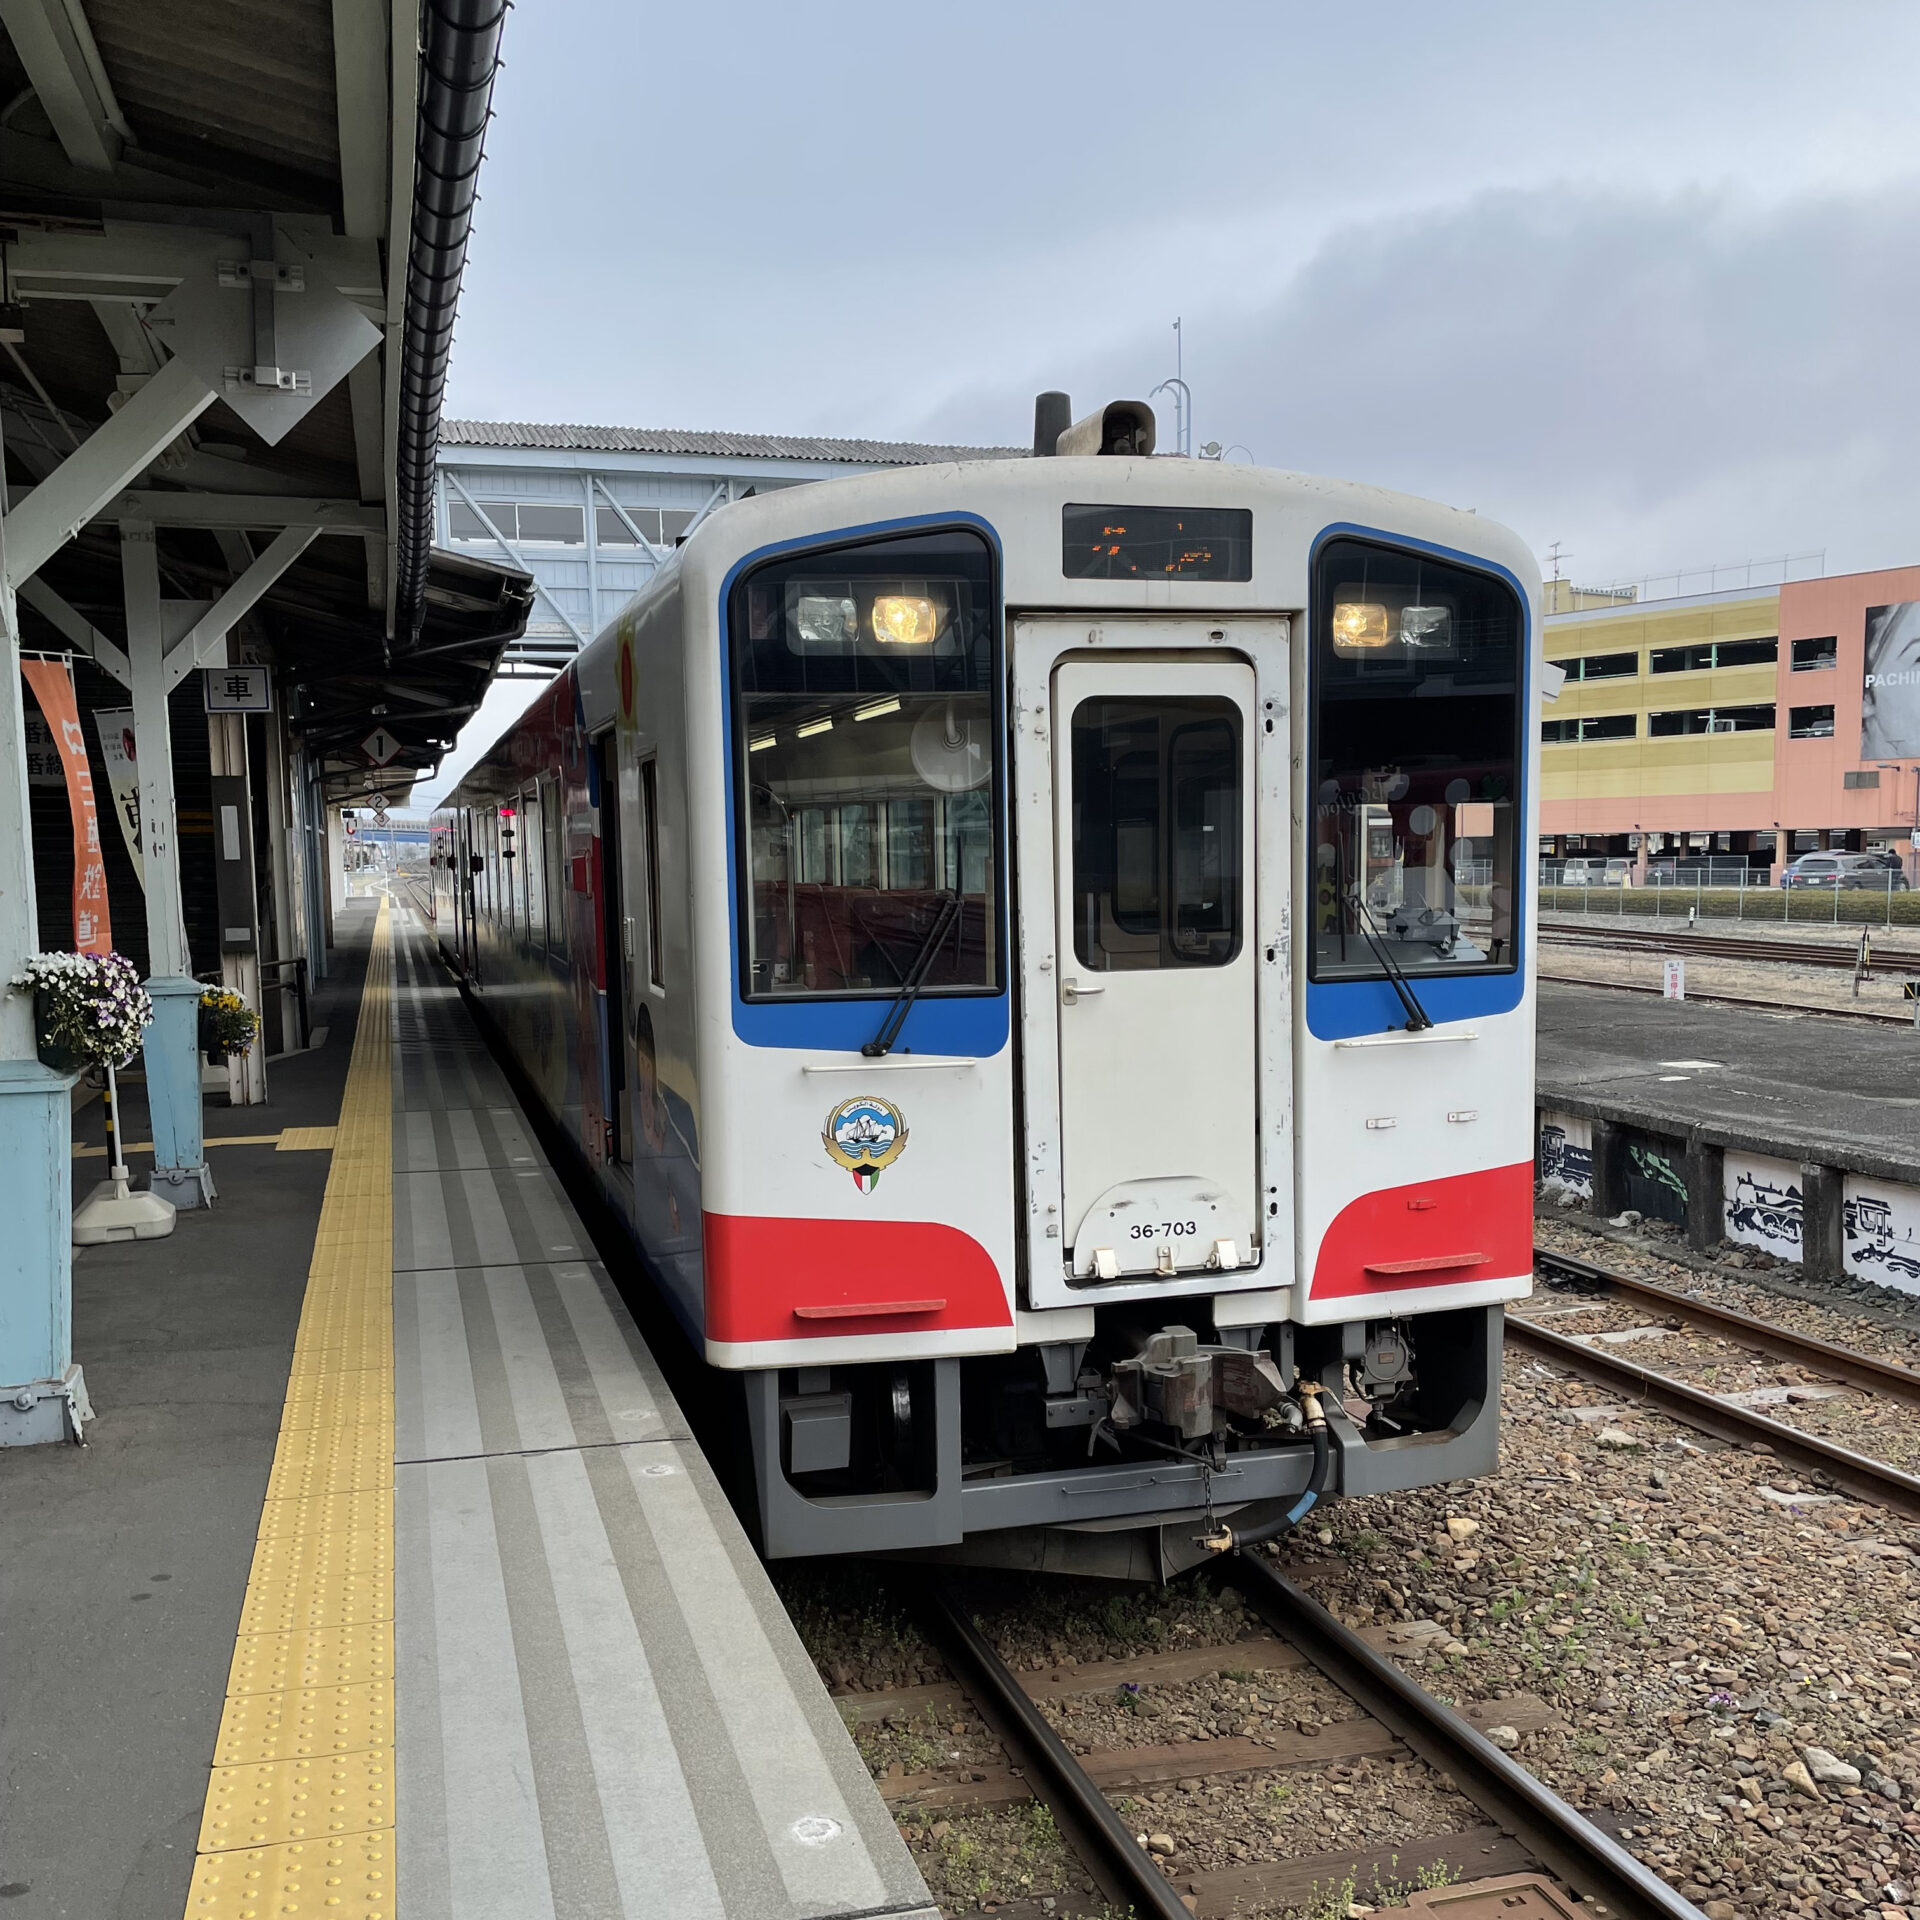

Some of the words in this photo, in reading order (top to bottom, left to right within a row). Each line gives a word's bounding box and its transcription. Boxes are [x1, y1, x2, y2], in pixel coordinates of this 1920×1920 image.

[223, 674, 253, 702] 車
[1864, 671, 1920, 688] PACHI
[376, 735, 384, 757] 1
[374, 795, 383, 809] 2
[379, 813, 385, 823] 3
[1130, 1221, 1197, 1239] 36-703
